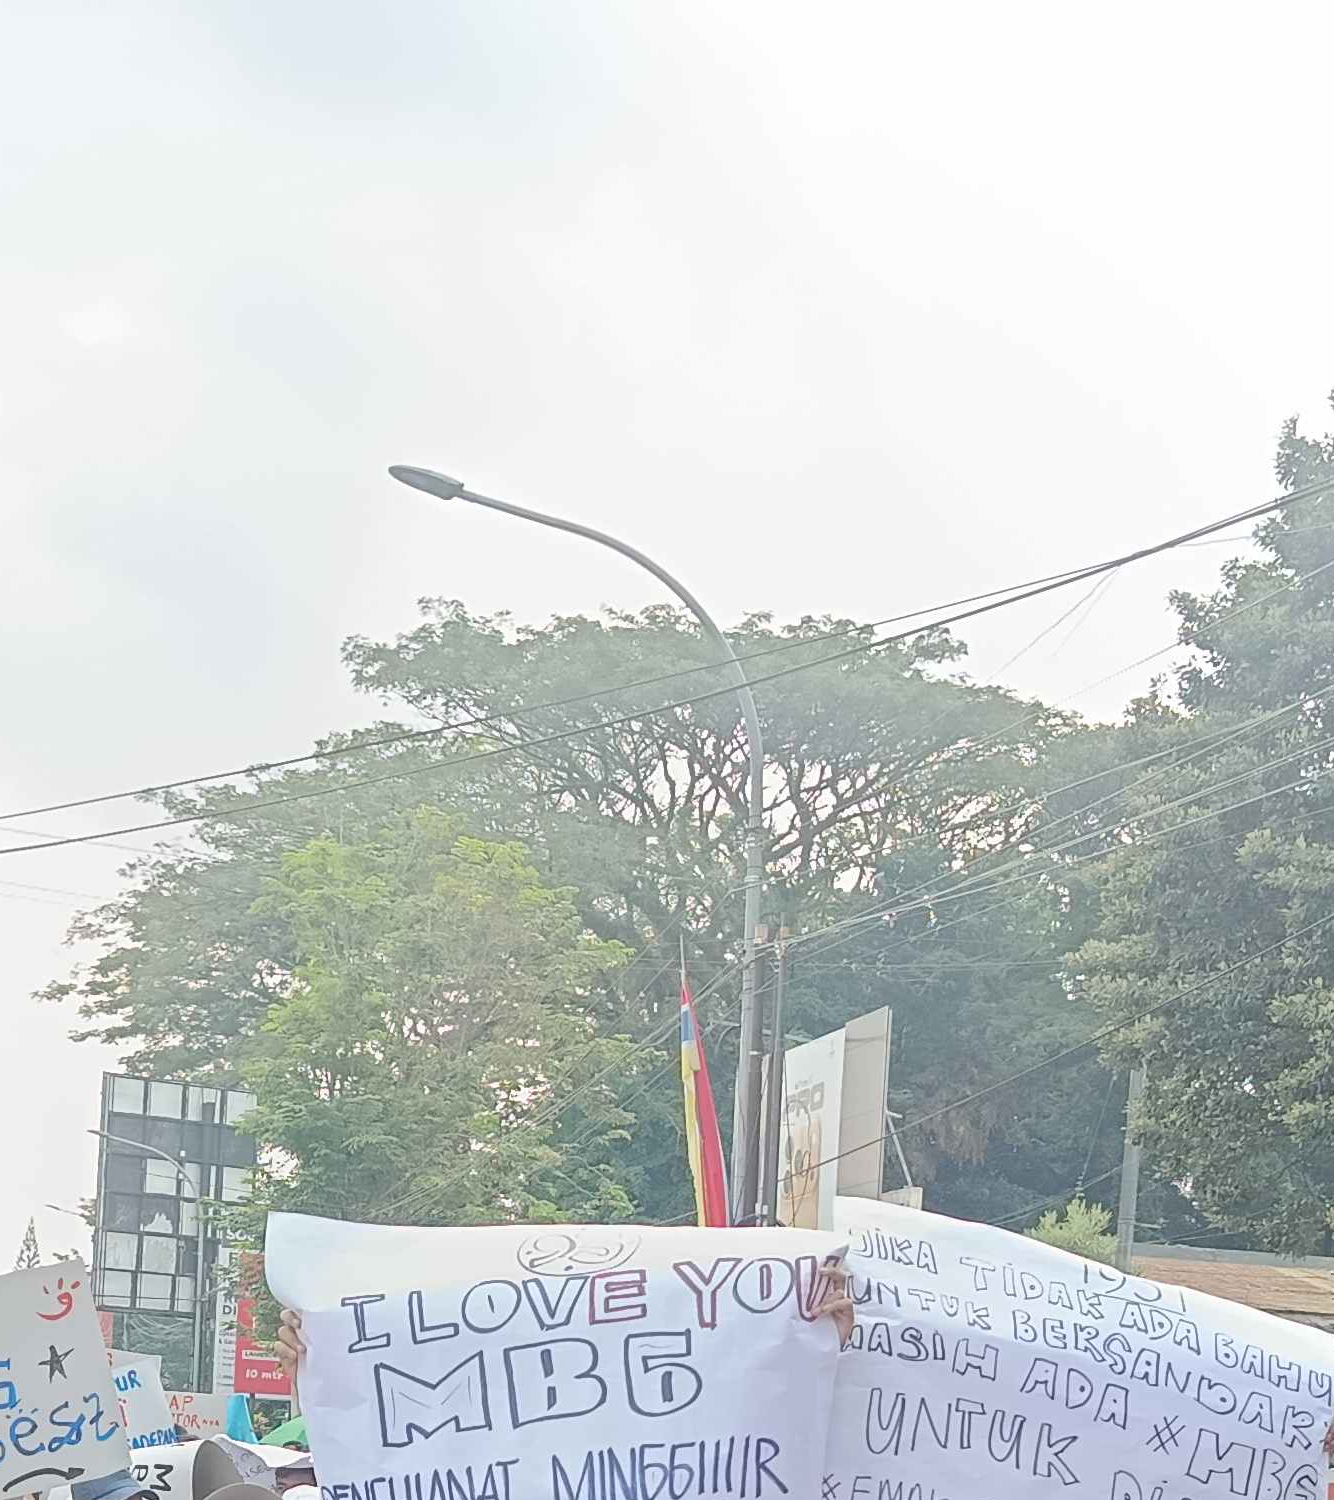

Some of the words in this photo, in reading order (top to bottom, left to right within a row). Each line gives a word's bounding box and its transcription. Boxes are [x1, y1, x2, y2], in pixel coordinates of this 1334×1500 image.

[341, 1293, 391, 1353] I
[406, 1269, 649, 1347] LOVE
[672, 1254, 845, 1330] YOU
[845, 1274, 992, 1330] UNTUK
[848, 1228, 938, 1274] JIKA
[959, 1256, 1105, 1320] TIDAK
[1120, 1302, 1201, 1356] ADA
[1214, 1332, 1333, 1407] BAHU
[244, 1367, 259, 1379] 10
[1019, 1357, 1130, 1430] ADA
[865, 1387, 1080, 1486] UNTUK
